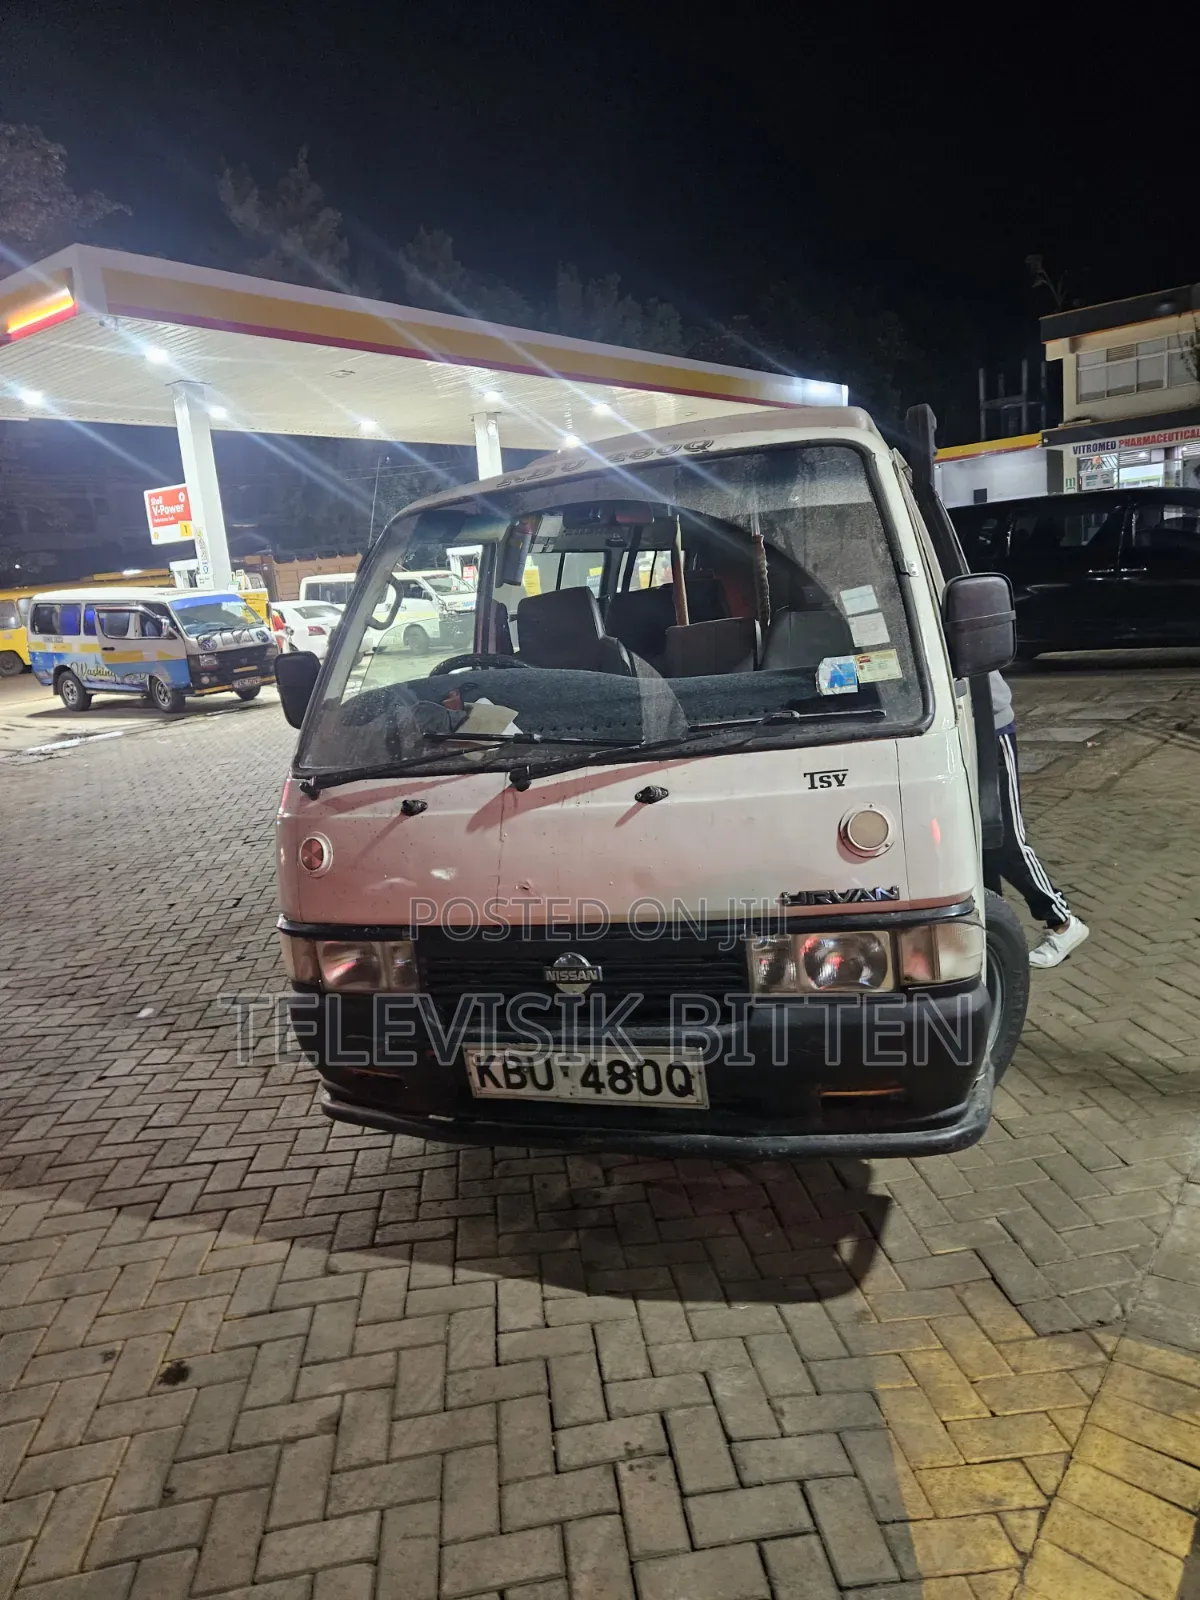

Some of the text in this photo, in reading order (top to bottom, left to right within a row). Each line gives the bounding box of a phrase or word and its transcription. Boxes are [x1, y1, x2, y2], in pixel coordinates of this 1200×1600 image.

[1072, 440, 1117, 455] VITROMED
[152, 503, 185, 516] V-Power
[545, 970, 598, 981] NISSAN
[475, 1055, 696, 1098] KBU 480Q
